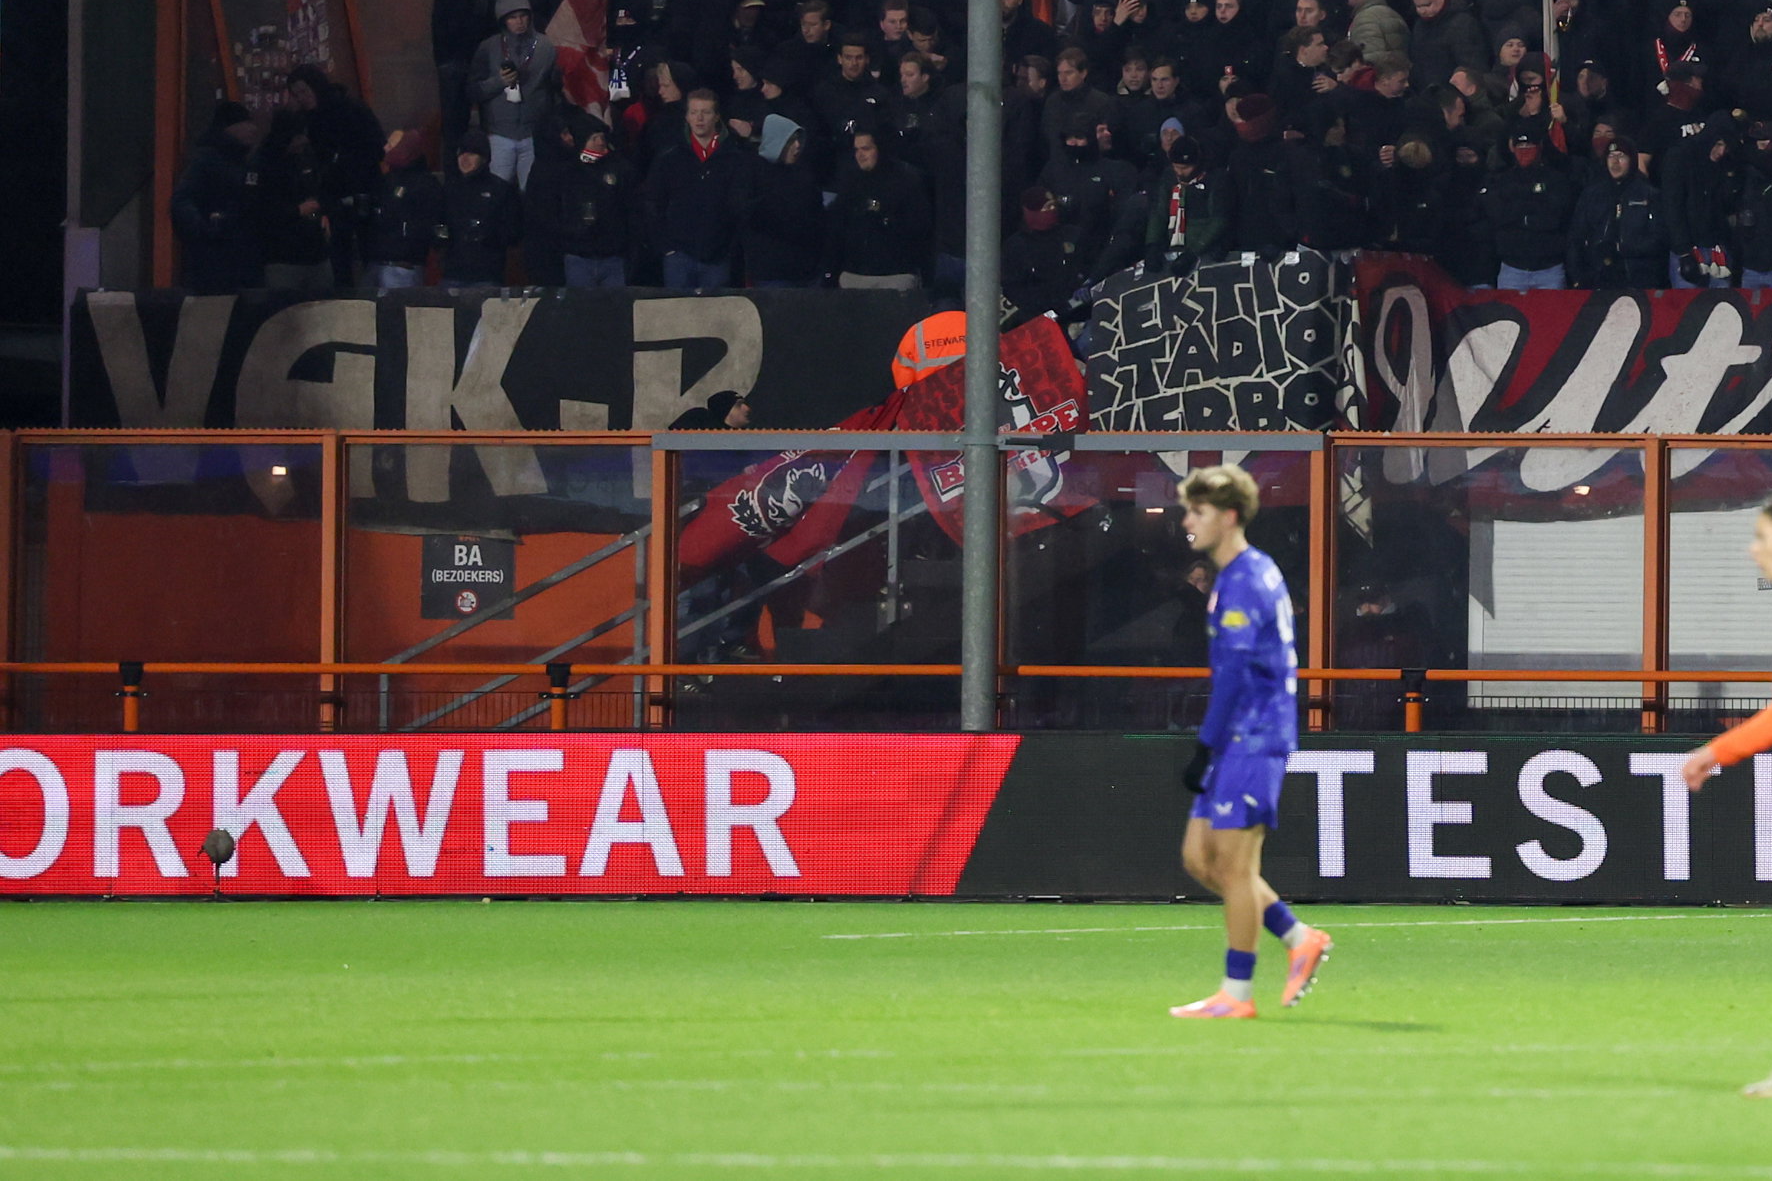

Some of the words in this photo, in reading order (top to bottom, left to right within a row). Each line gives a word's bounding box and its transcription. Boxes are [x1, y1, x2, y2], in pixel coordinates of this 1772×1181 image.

[924, 334, 966, 350] STEWAR
[454, 545, 482, 566] BA
[432, 568, 504, 583] (BEZOEKERS)
[0, 748, 801, 878] ORKWEAR
